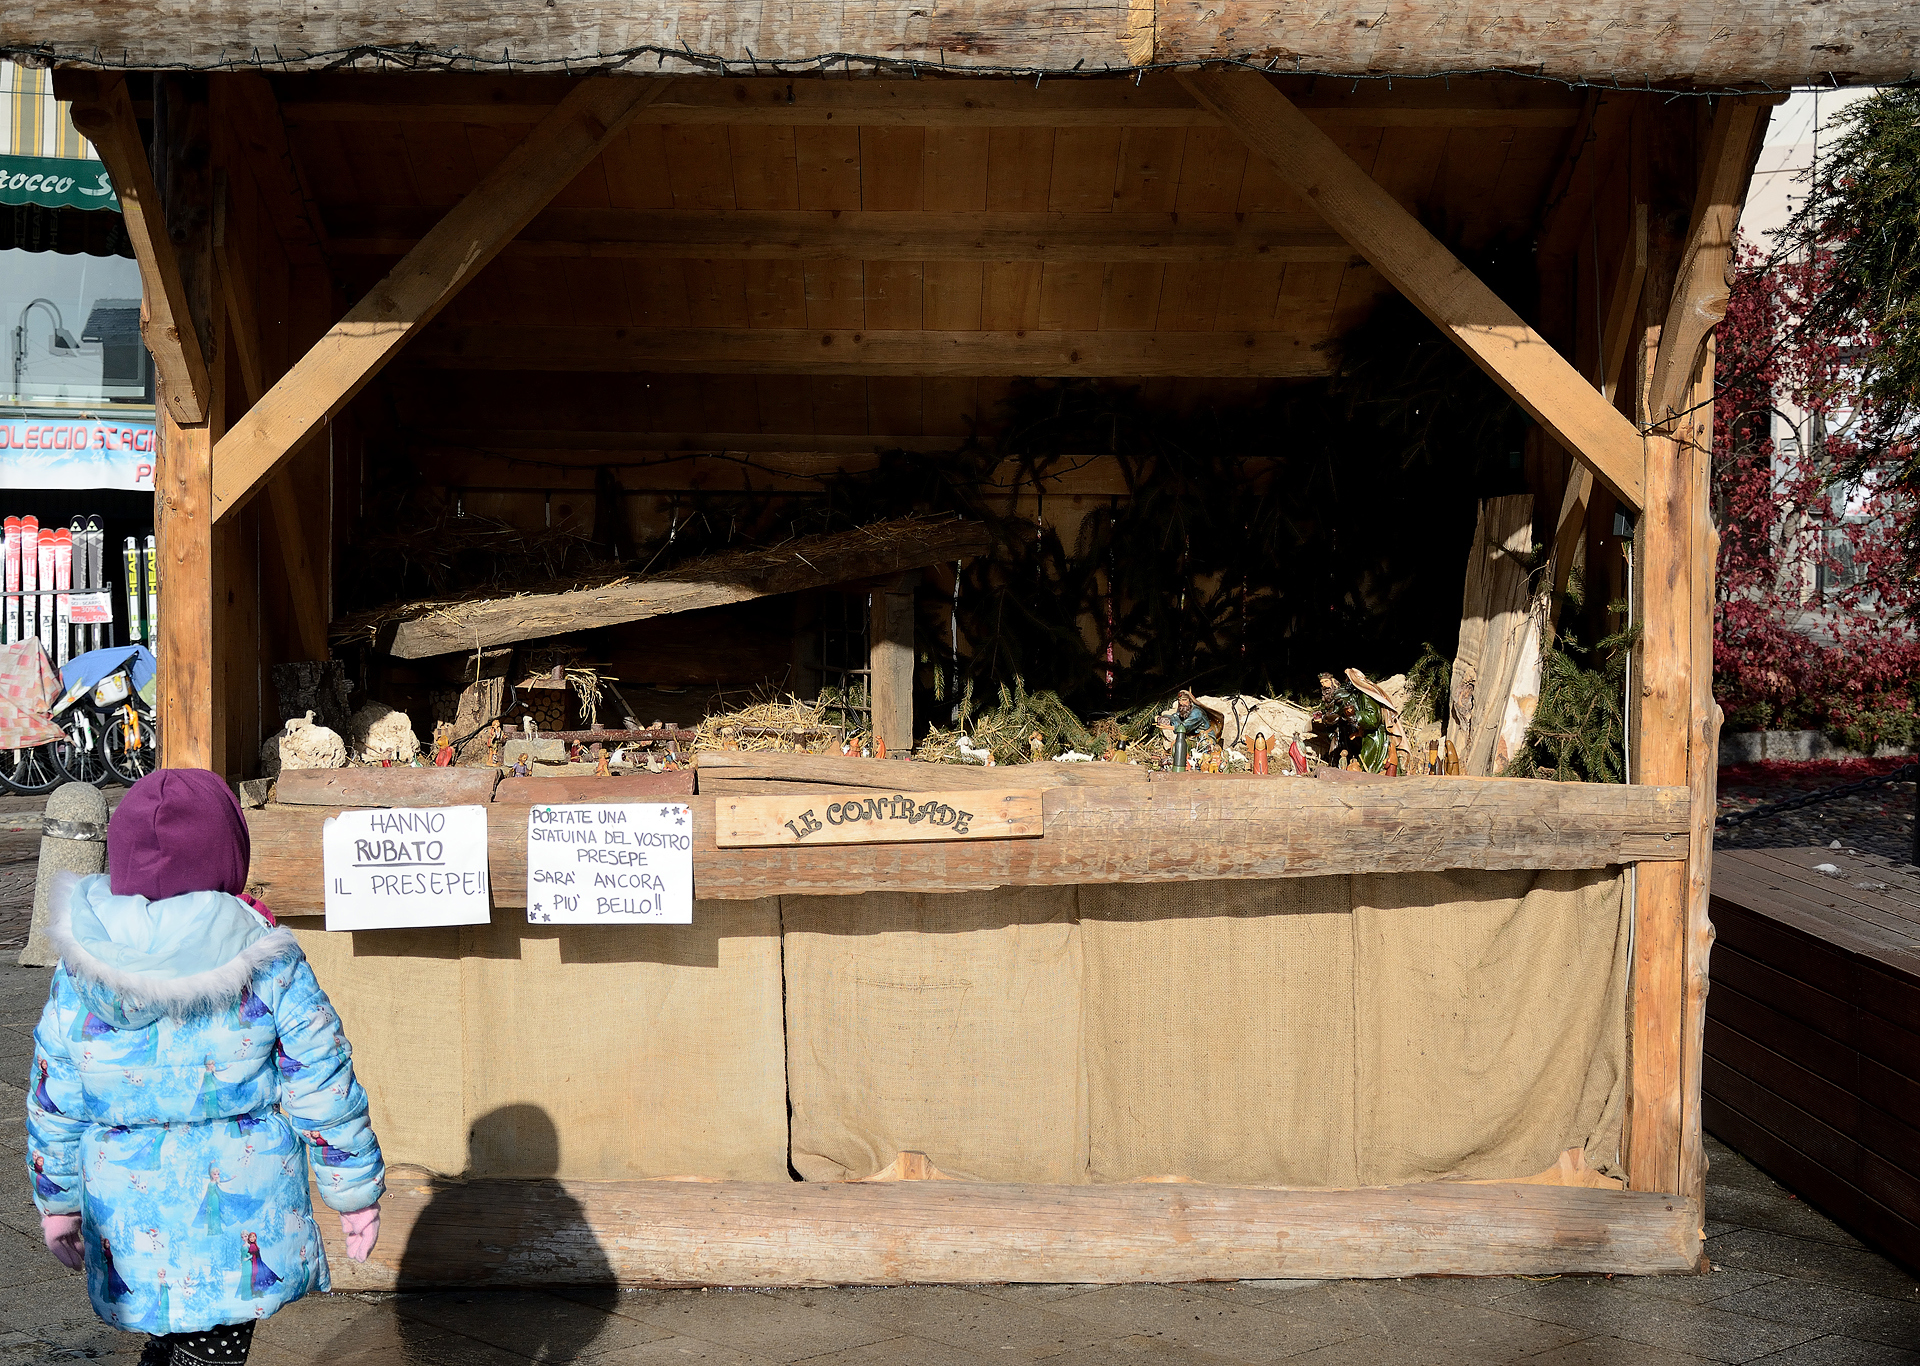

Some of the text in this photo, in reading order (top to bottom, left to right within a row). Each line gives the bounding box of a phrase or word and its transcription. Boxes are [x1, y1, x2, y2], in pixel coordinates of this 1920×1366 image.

[78, 172, 117, 200] S
[91, 427, 156, 452] STAGI
[135, 464, 156, 483] P
[127, 549, 138, 596] HEAD
[147, 547, 157, 595] HEAD
[371, 812, 445, 834] HANNO
[532, 809, 627, 824] PORTATE UNA
[785, 794, 974, 841] LE CONTRADE
[354, 839, 444, 862] RUBATO
[531, 828, 690, 851] STATUINA DEL VOSTRO
[577, 849, 648, 867] PRESEPE
[335, 870, 486, 896] IL PRESEPE!!
[594, 872, 666, 892] ANCORA
[597, 893, 663, 916] BELLO!!
